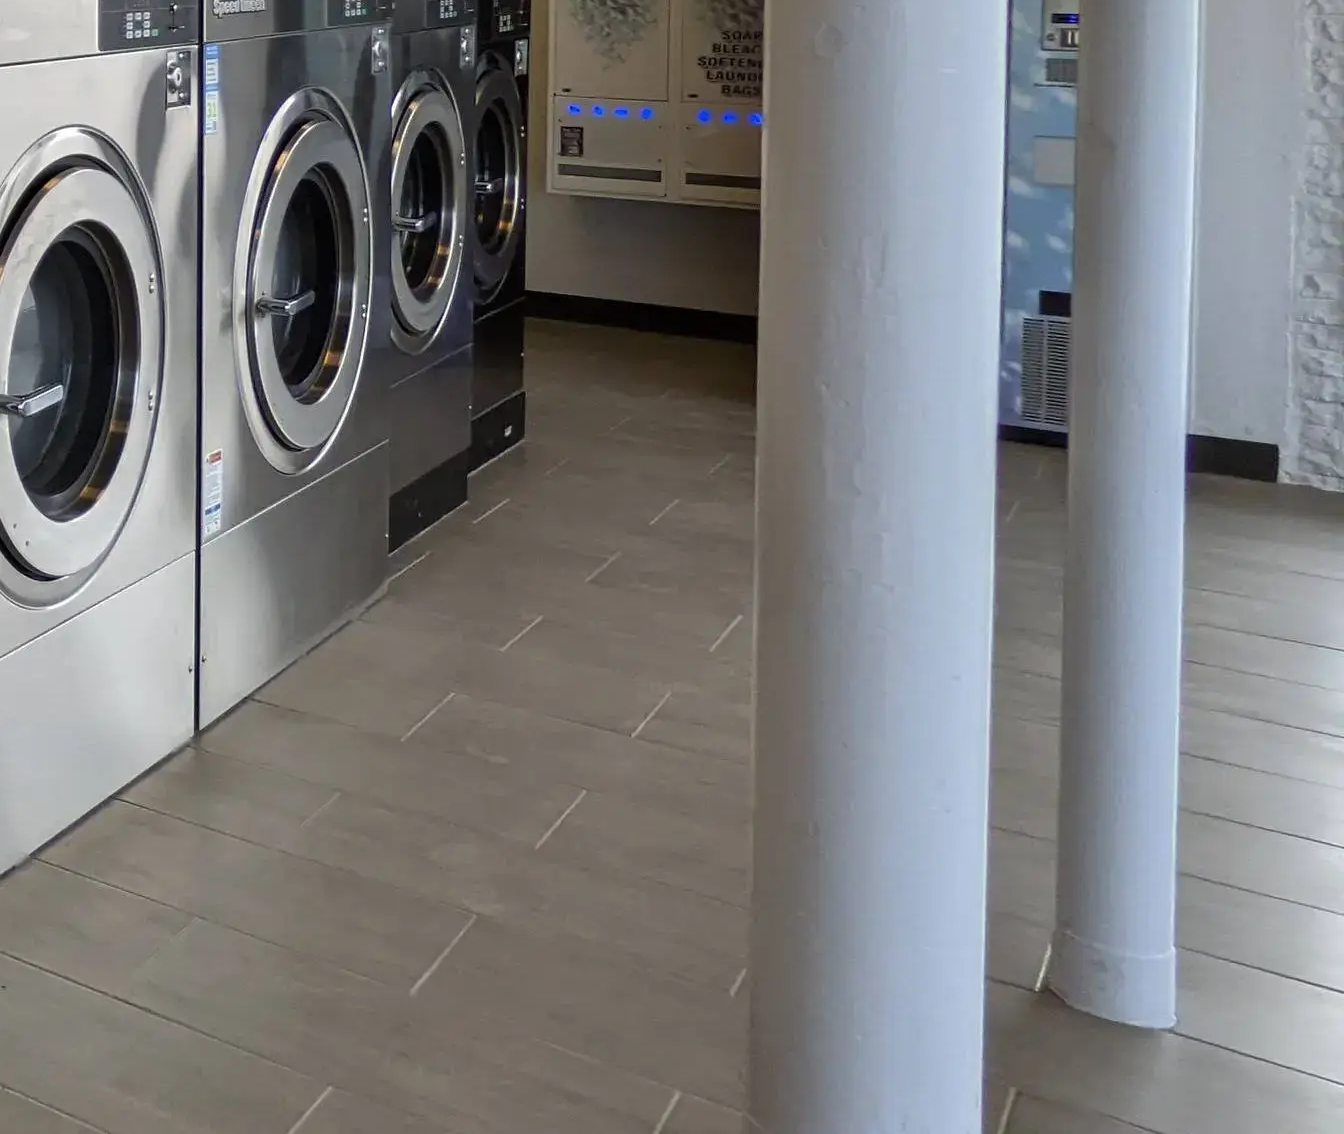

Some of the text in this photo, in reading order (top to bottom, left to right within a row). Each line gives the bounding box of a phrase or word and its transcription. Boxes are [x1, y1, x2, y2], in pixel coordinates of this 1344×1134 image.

[721, 30, 762, 41] SOAP
[712, 43, 761, 54] BLEAC
[697, 56, 762, 67] SOFTEN
[706, 70, 762, 81] LAUND
